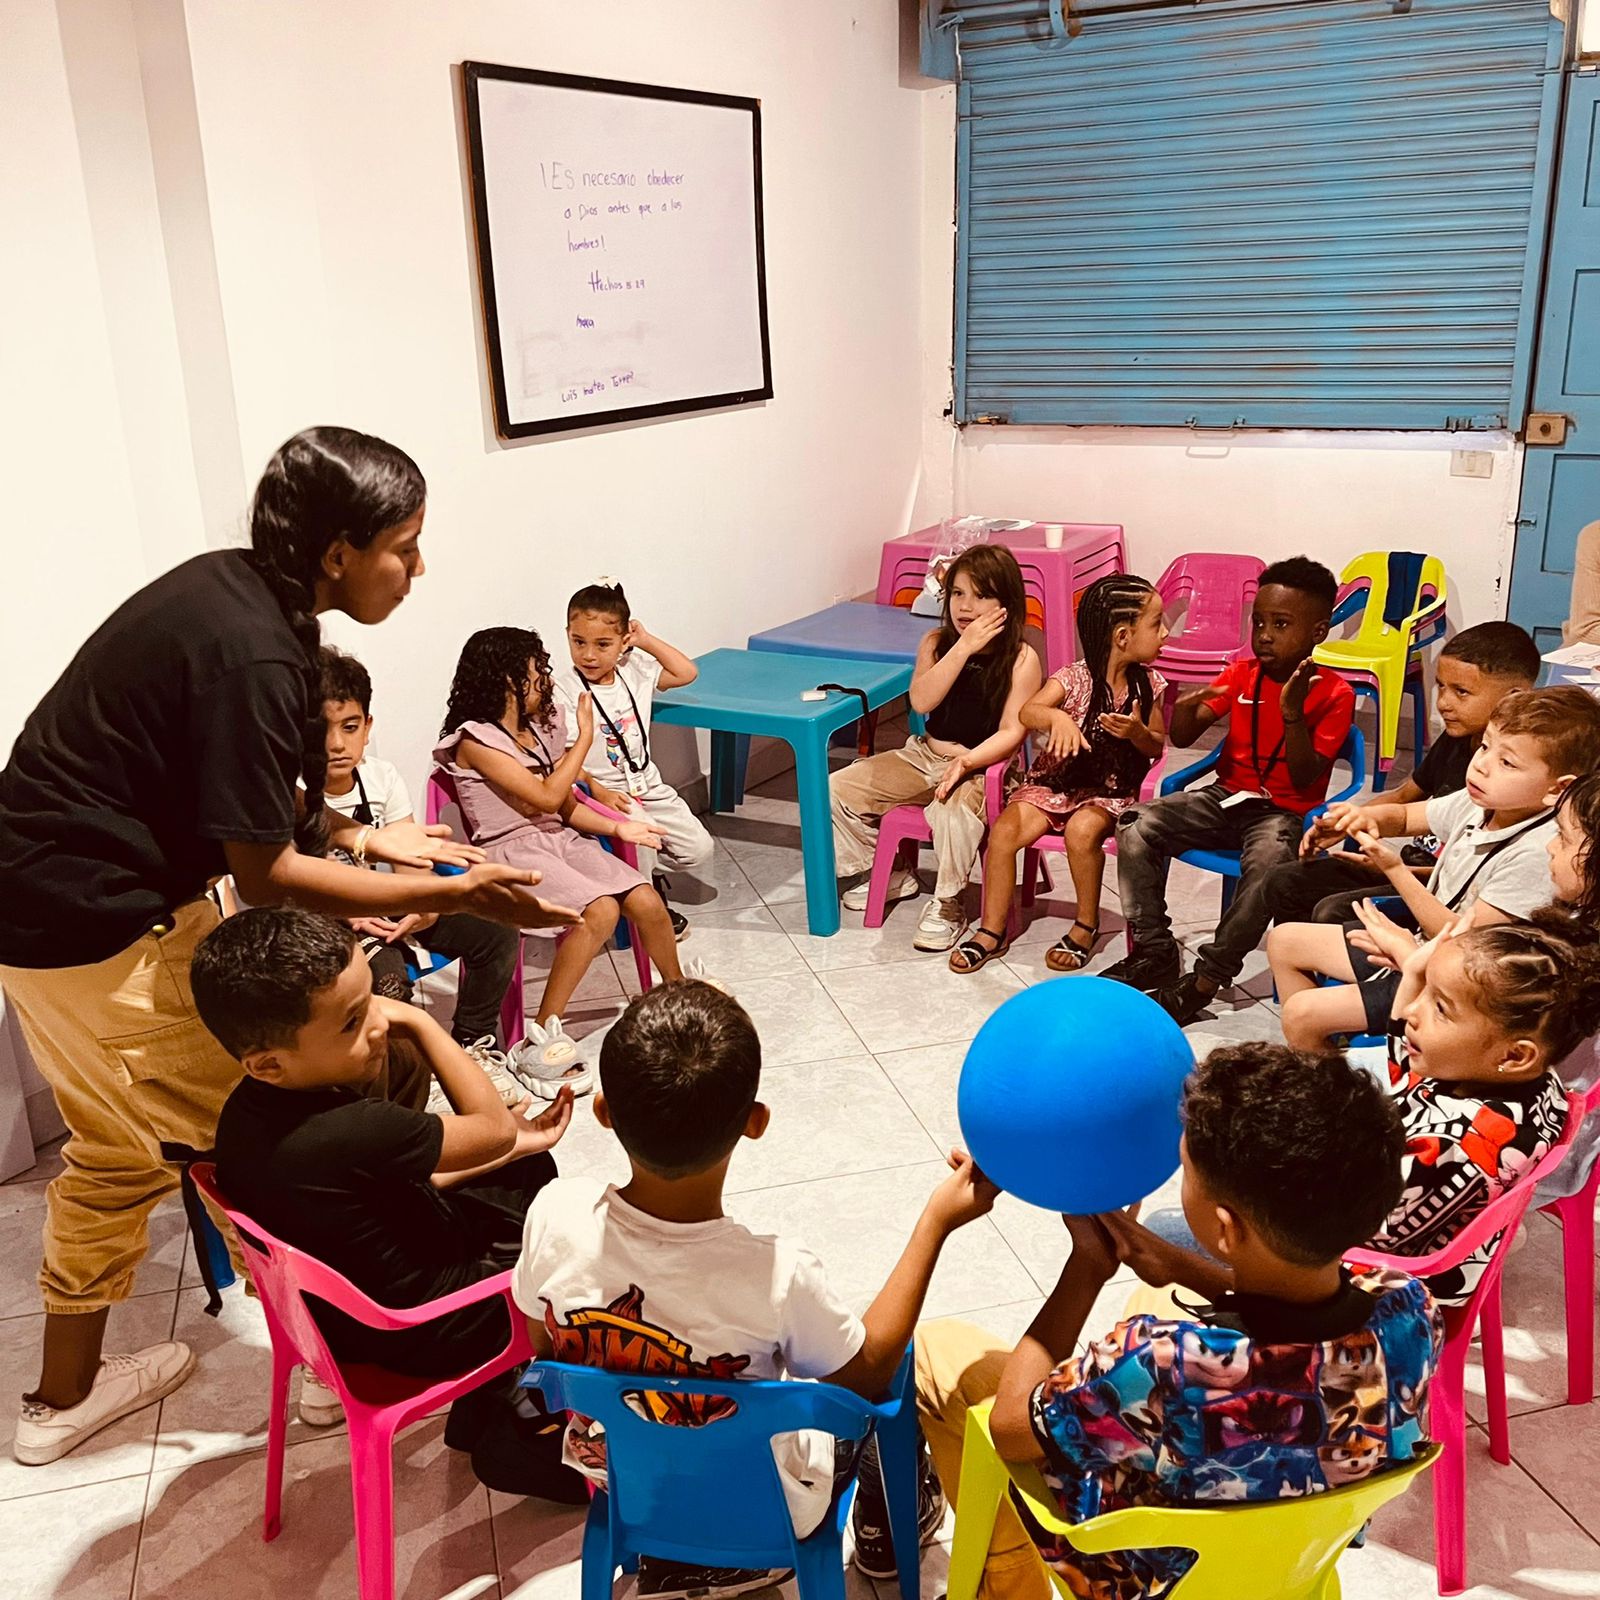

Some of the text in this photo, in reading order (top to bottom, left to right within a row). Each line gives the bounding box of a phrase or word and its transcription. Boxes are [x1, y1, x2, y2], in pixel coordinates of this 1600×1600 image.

[582, 171, 636, 187] necesario
[564, 198, 682, 221] a Dios antes que a los
[588, 269, 623, 293] Hechos
